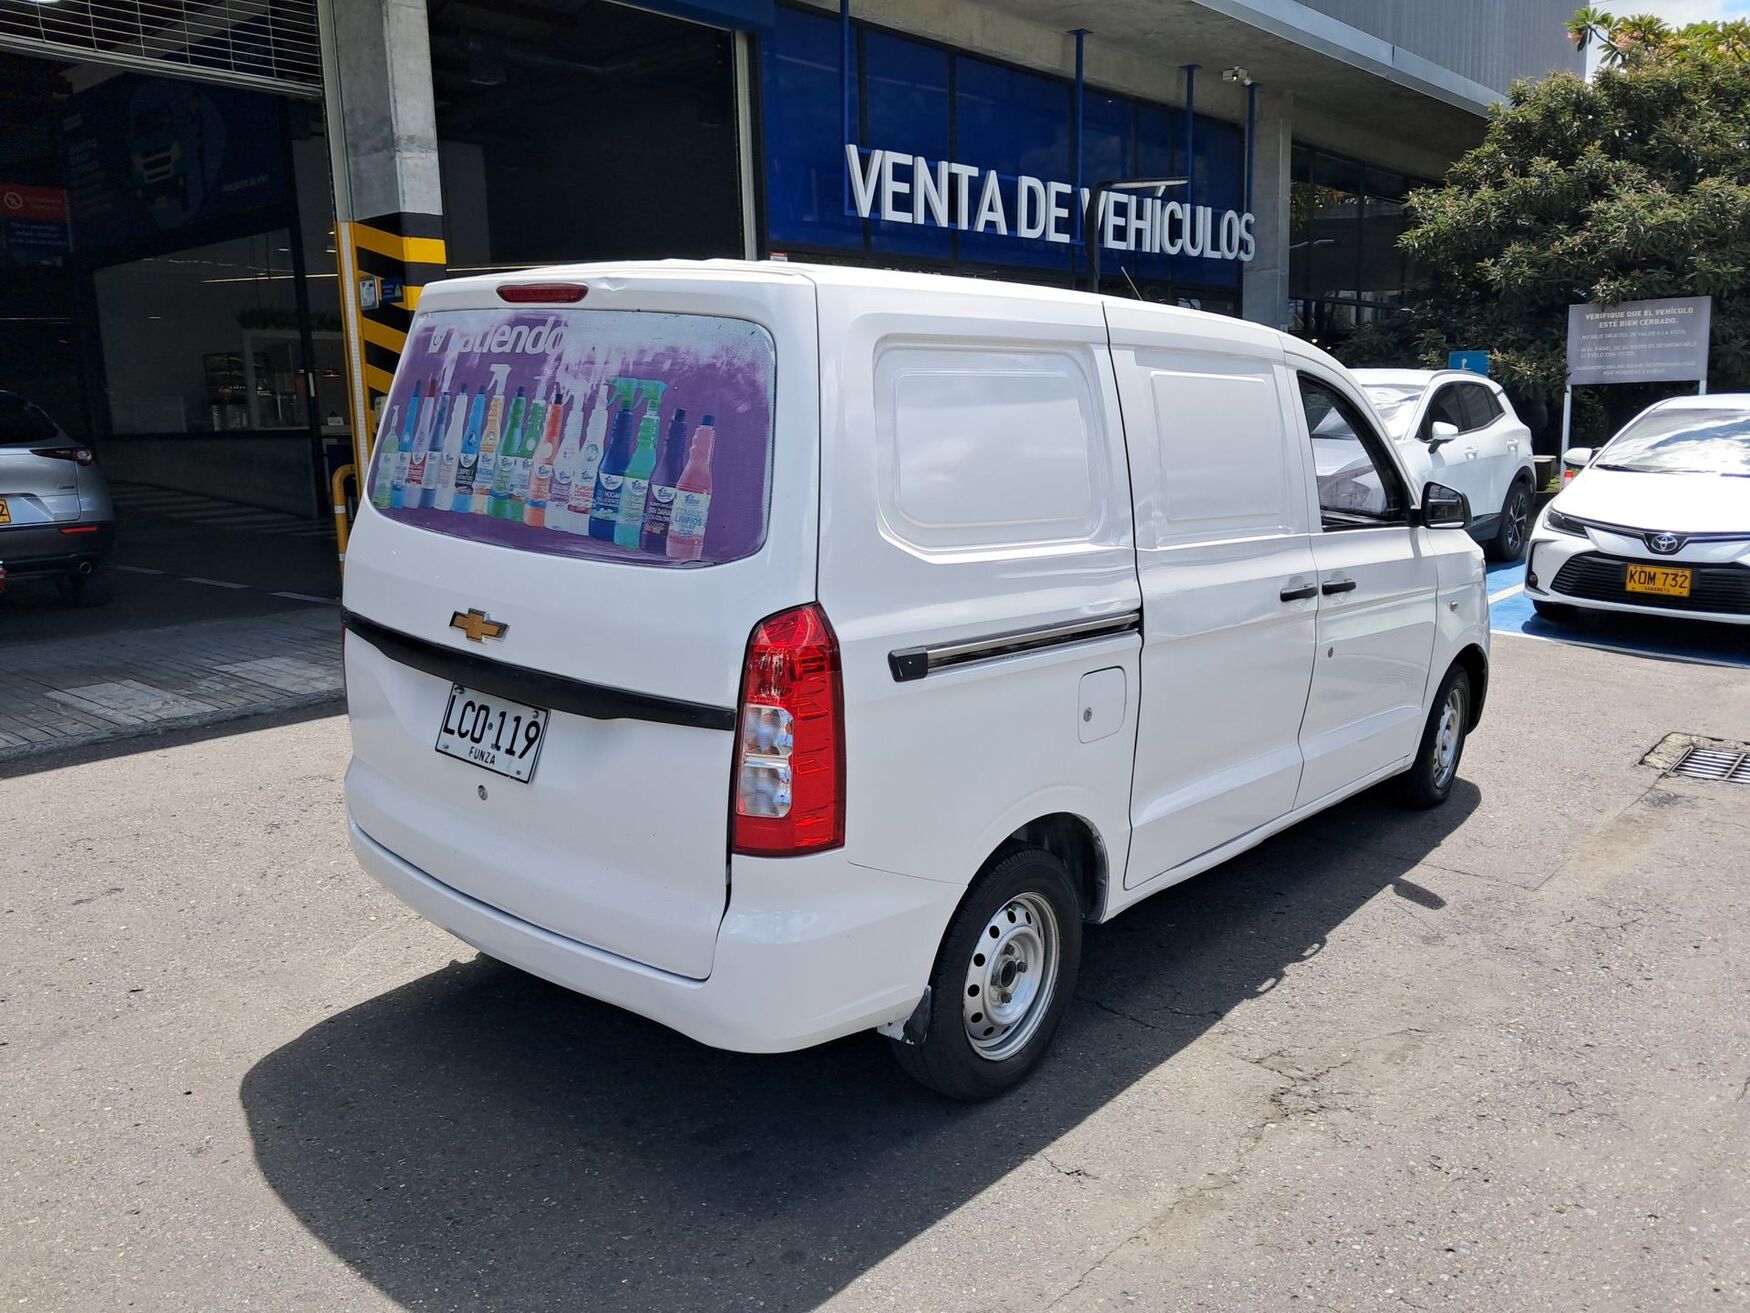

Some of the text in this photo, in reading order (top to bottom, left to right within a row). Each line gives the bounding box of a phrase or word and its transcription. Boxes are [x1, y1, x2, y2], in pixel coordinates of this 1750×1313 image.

[845, 144, 1257, 262] VENTA DE VEHÍCULOS
[1585, 306, 1694, 320] VERIFIQUE QUE EL VEHÍCULO
[1599, 319, 1618, 328] ESTÉ
[1620, 319, 1638, 327] BIEN
[1661, 572, 1688, 588] 732
[468, 746, 496, 765] FUNZA
